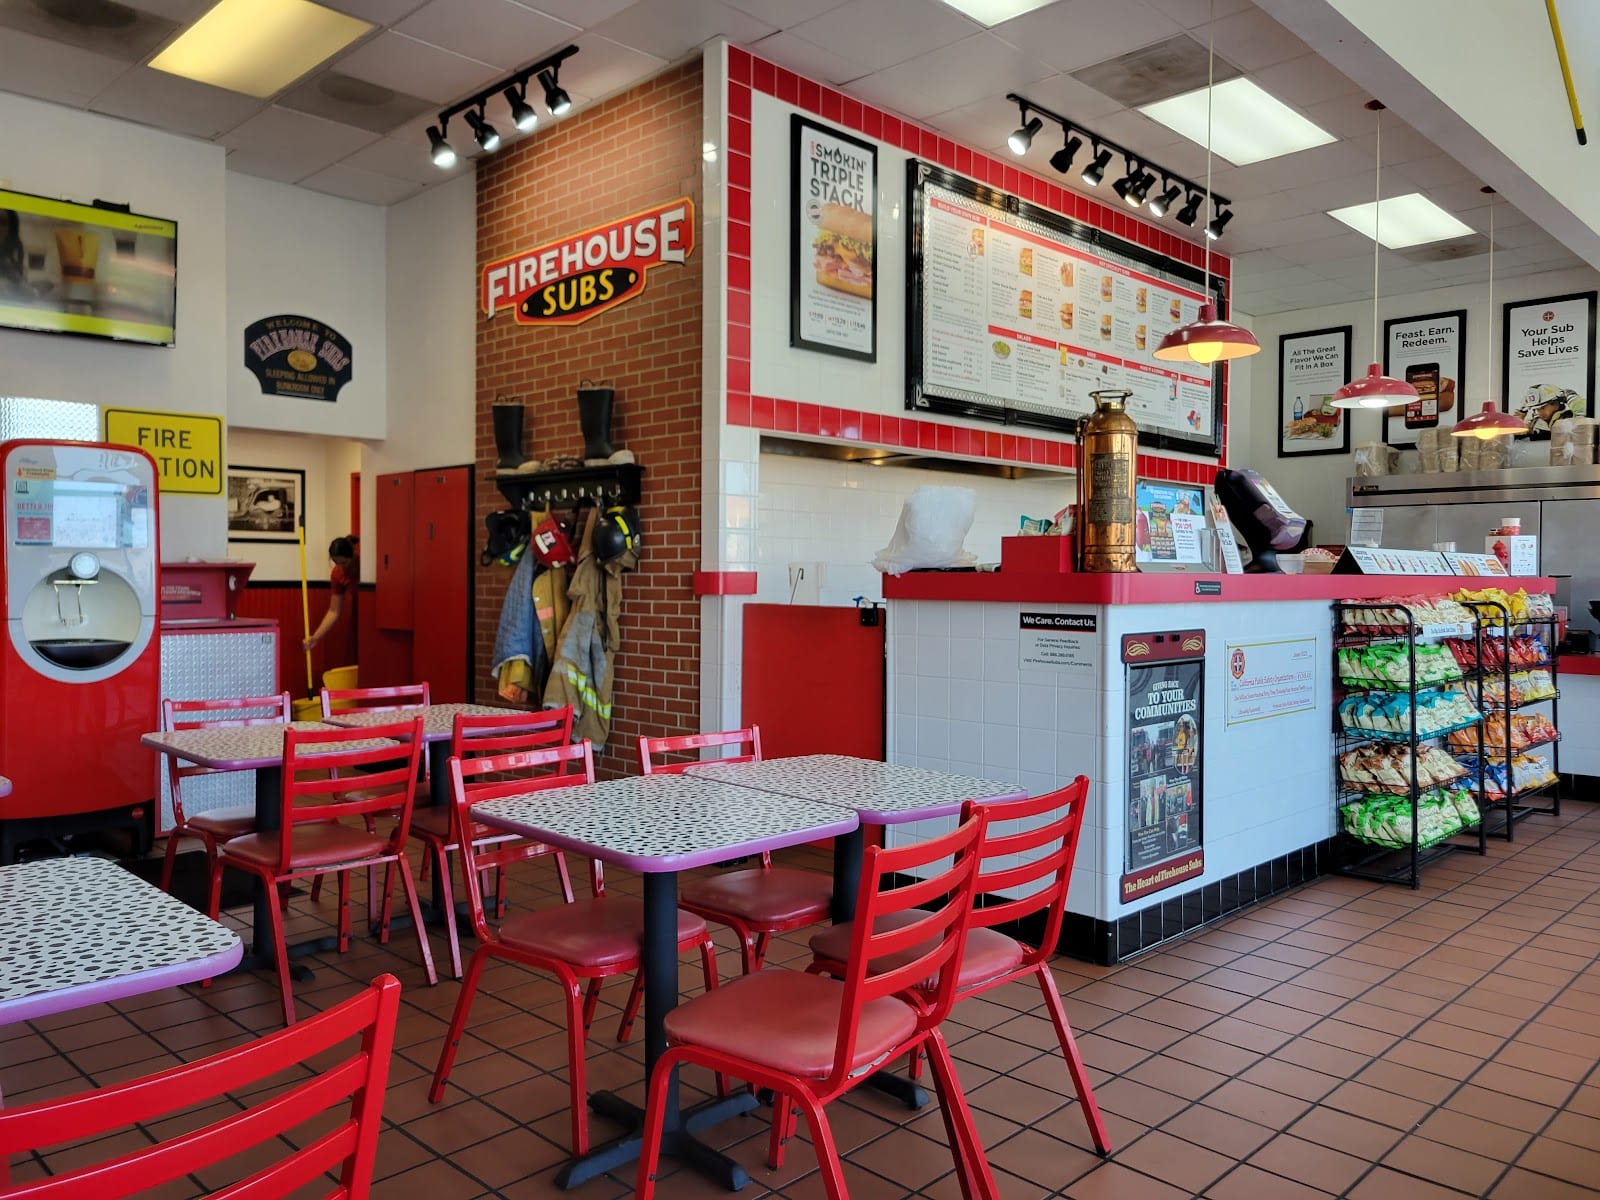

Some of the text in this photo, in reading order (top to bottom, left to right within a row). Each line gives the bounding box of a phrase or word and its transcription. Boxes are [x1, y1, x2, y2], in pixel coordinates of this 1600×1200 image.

[810, 157, 864, 193] TRIPLE
[810, 177, 864, 213] STACK
[487, 205, 686, 320] FIREHOUSE
[543, 269, 614, 316] SUBS
[265, 319, 319, 332] WELCOME
[1428, 327, 1455, 336] Earn.
[1521, 323, 1574, 337] Your Sub
[1316, 345, 1336, 353] Great
[1402, 337, 1448, 348] Redeem.
[1532, 336, 1565, 347] Helps
[1517, 345, 1580, 358] Save Lives
[138, 427, 192, 450] FIRE
[159, 457, 214, 479] TION
[1022, 616, 1096, 627] We Care. Contact Us.
[1152, 680, 1168, 692] GIVING
[1147, 688, 1185, 705] TO YOUR
[1135, 699, 1197, 720] COMMUNITIES
[1124, 858, 1202, 894] The Heart of Firehouse Subs
